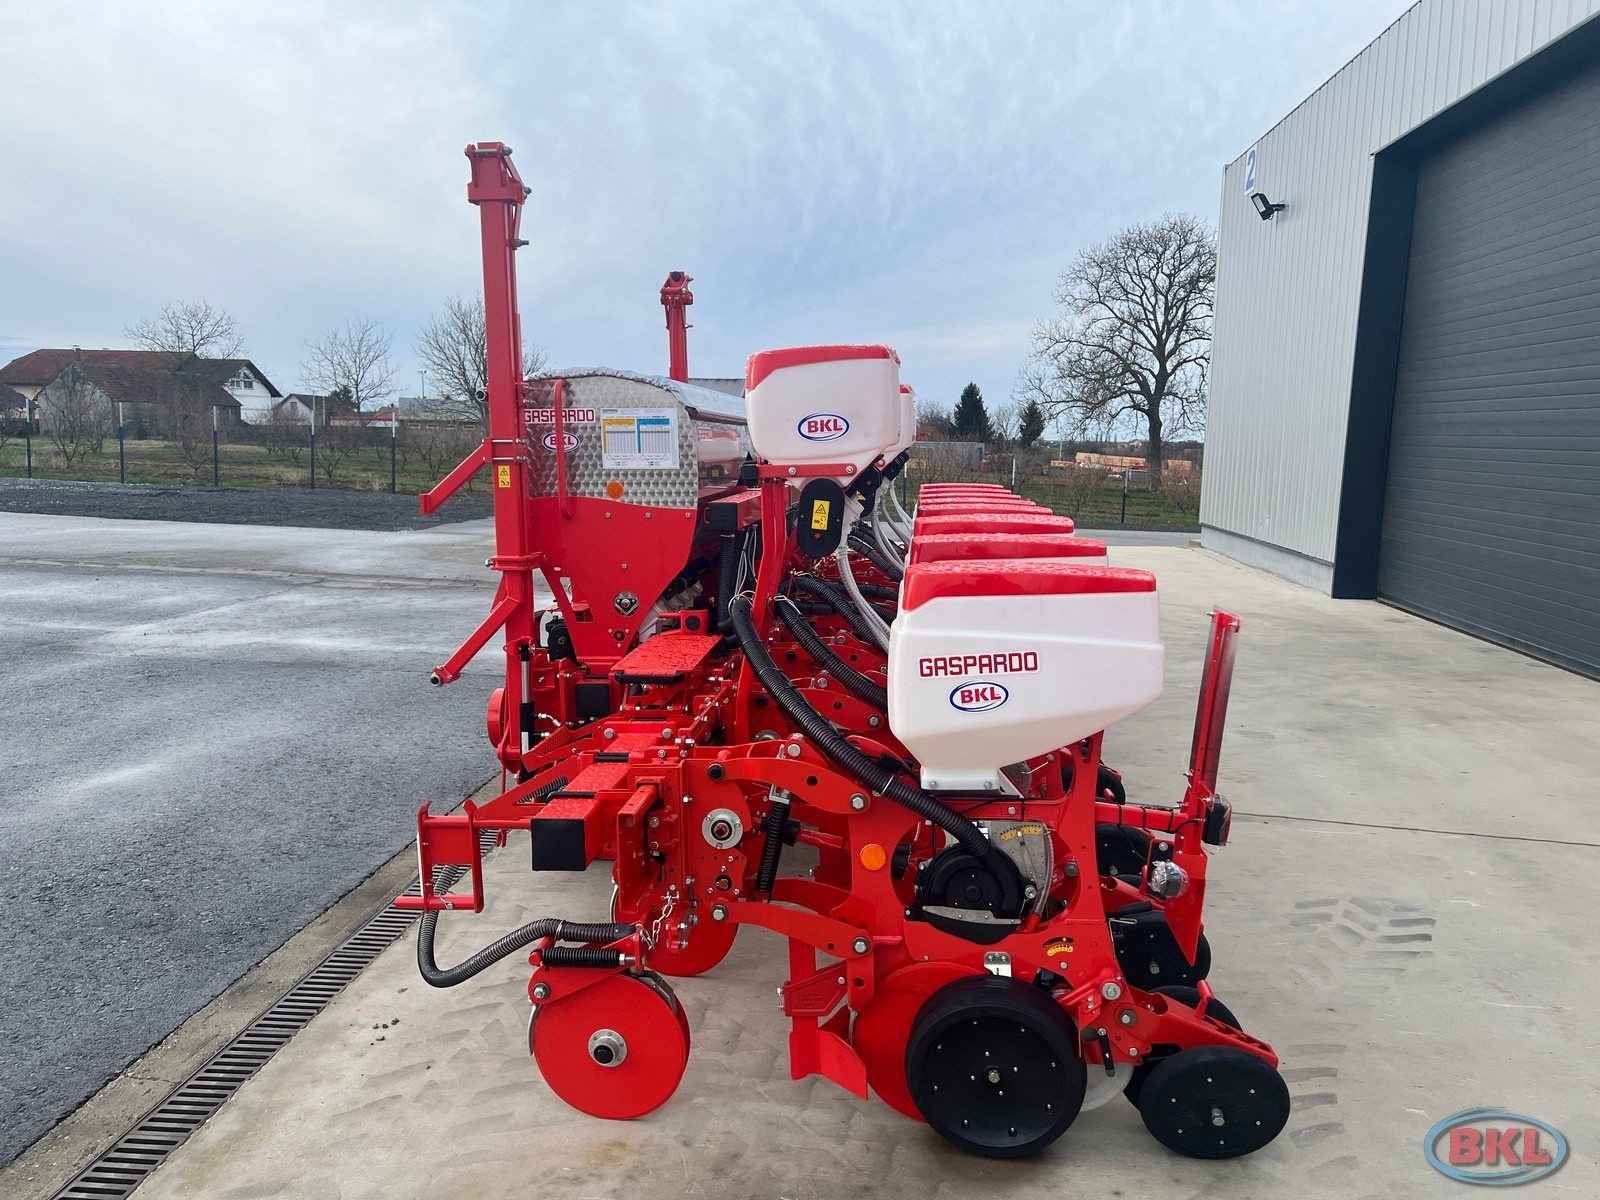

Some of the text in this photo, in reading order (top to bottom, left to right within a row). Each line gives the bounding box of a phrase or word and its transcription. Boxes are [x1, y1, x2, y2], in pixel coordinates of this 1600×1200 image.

[1245, 149, 1256, 192] 2
[807, 418, 843, 434] BKL
[919, 651, 1038, 678] GASPARDO
[960, 686, 1002, 704] BKL
